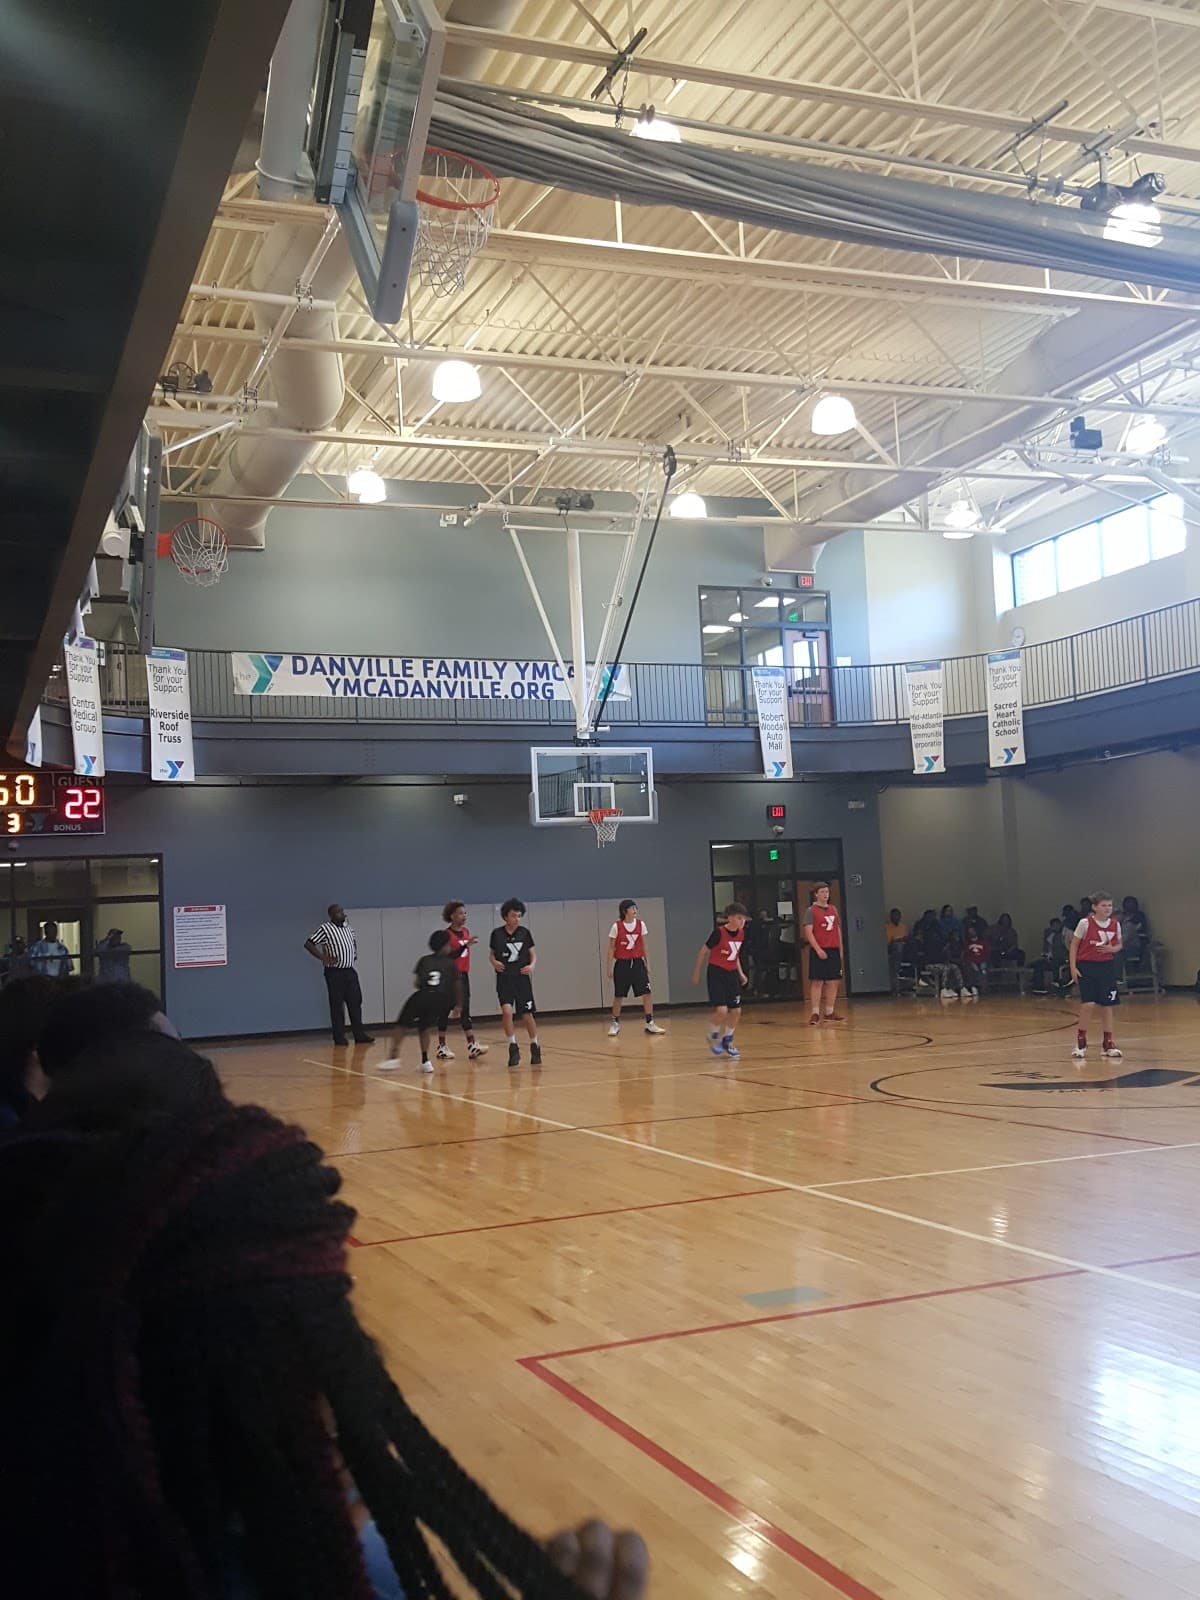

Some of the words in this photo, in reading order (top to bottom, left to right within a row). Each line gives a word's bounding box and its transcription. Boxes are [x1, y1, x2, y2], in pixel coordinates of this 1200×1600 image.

[86, 655, 96, 665] You
[80, 665, 92, 674] your
[148, 663, 171, 674] Thank
[173, 666, 187, 676] You
[292, 655, 414, 678] DANVILLE
[422, 659, 508, 681] FAMILY
[515, 662, 575, 682] YMCA
[989, 666, 1007, 676] Thank
[1008, 664, 1021, 672] You
[69, 670, 93, 683] Support
[153, 673, 164, 683] for
[166, 676, 183, 684] your
[1002, 673, 1017, 681] your
[153, 682, 183, 694] Support
[325, 677, 555, 699] YMCADANVILLE.ORG
[755, 680, 773, 689] Thank
[774, 681, 785, 689] You
[908, 683, 928, 691] Thank
[993, 680, 1018, 690] Support
[758, 688, 767, 696] for
[769, 689, 782, 697] your
[912, 691, 921, 699] for
[923, 690, 939, 698] your
[71, 696, 96, 709] Centra
[759, 696, 783, 704] Support
[912, 697, 940, 706] Support
[993, 701, 1018, 711] Sacred
[150, 708, 189, 720] Riverside
[760, 712, 785, 721] Robert
[996, 710, 1016, 720] Heart
[75, 721, 97, 734] Group
[159, 721, 179, 731] Roof
[992, 719, 1021, 729] Catholic
[766, 732, 783, 741] Auto
[995, 727, 1018, 737] School
[158, 733, 182, 744] Truss
[768, 741, 783, 750] Mall
[65, 789, 100, 819] 22
[7, 812, 20, 833] 3
[53, 824, 81, 832] BONUS
[427, 970, 441, 986] 3
